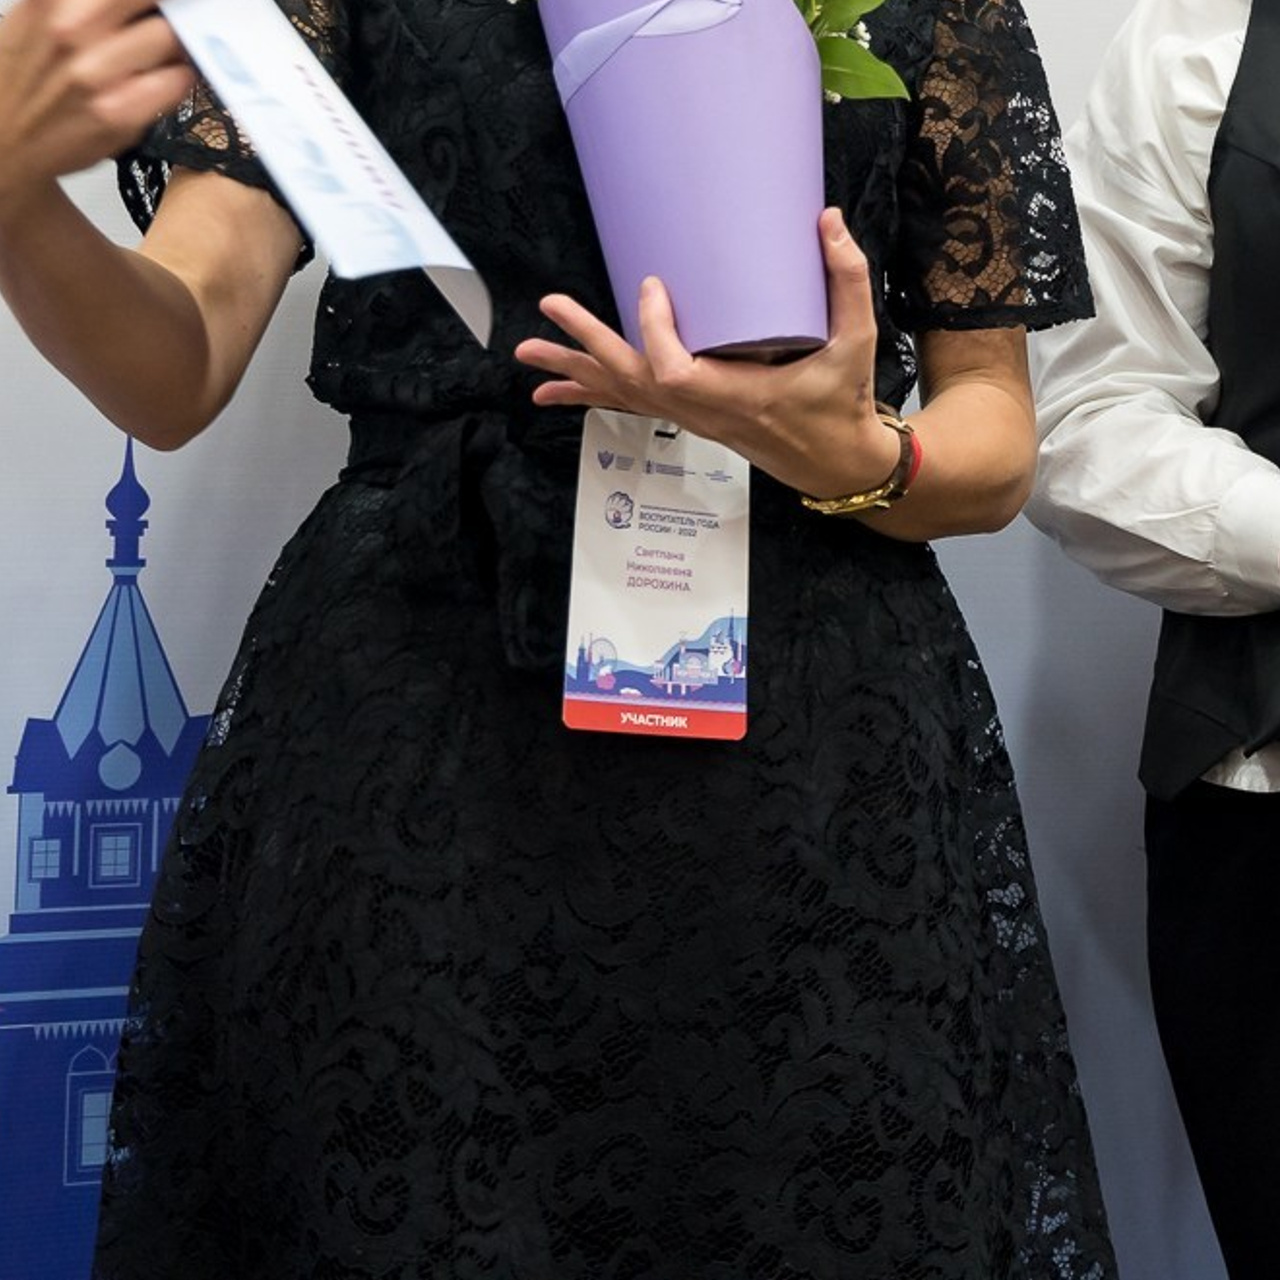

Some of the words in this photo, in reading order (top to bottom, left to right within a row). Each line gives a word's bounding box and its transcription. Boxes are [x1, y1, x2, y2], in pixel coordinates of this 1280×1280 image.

[634, 545, 686, 562] Светлана
[626, 561, 693, 578] Николаевна
[626, 576, 692, 592] ДОРОХИНА
[620, 711, 689, 729] УЧАСТНИК
